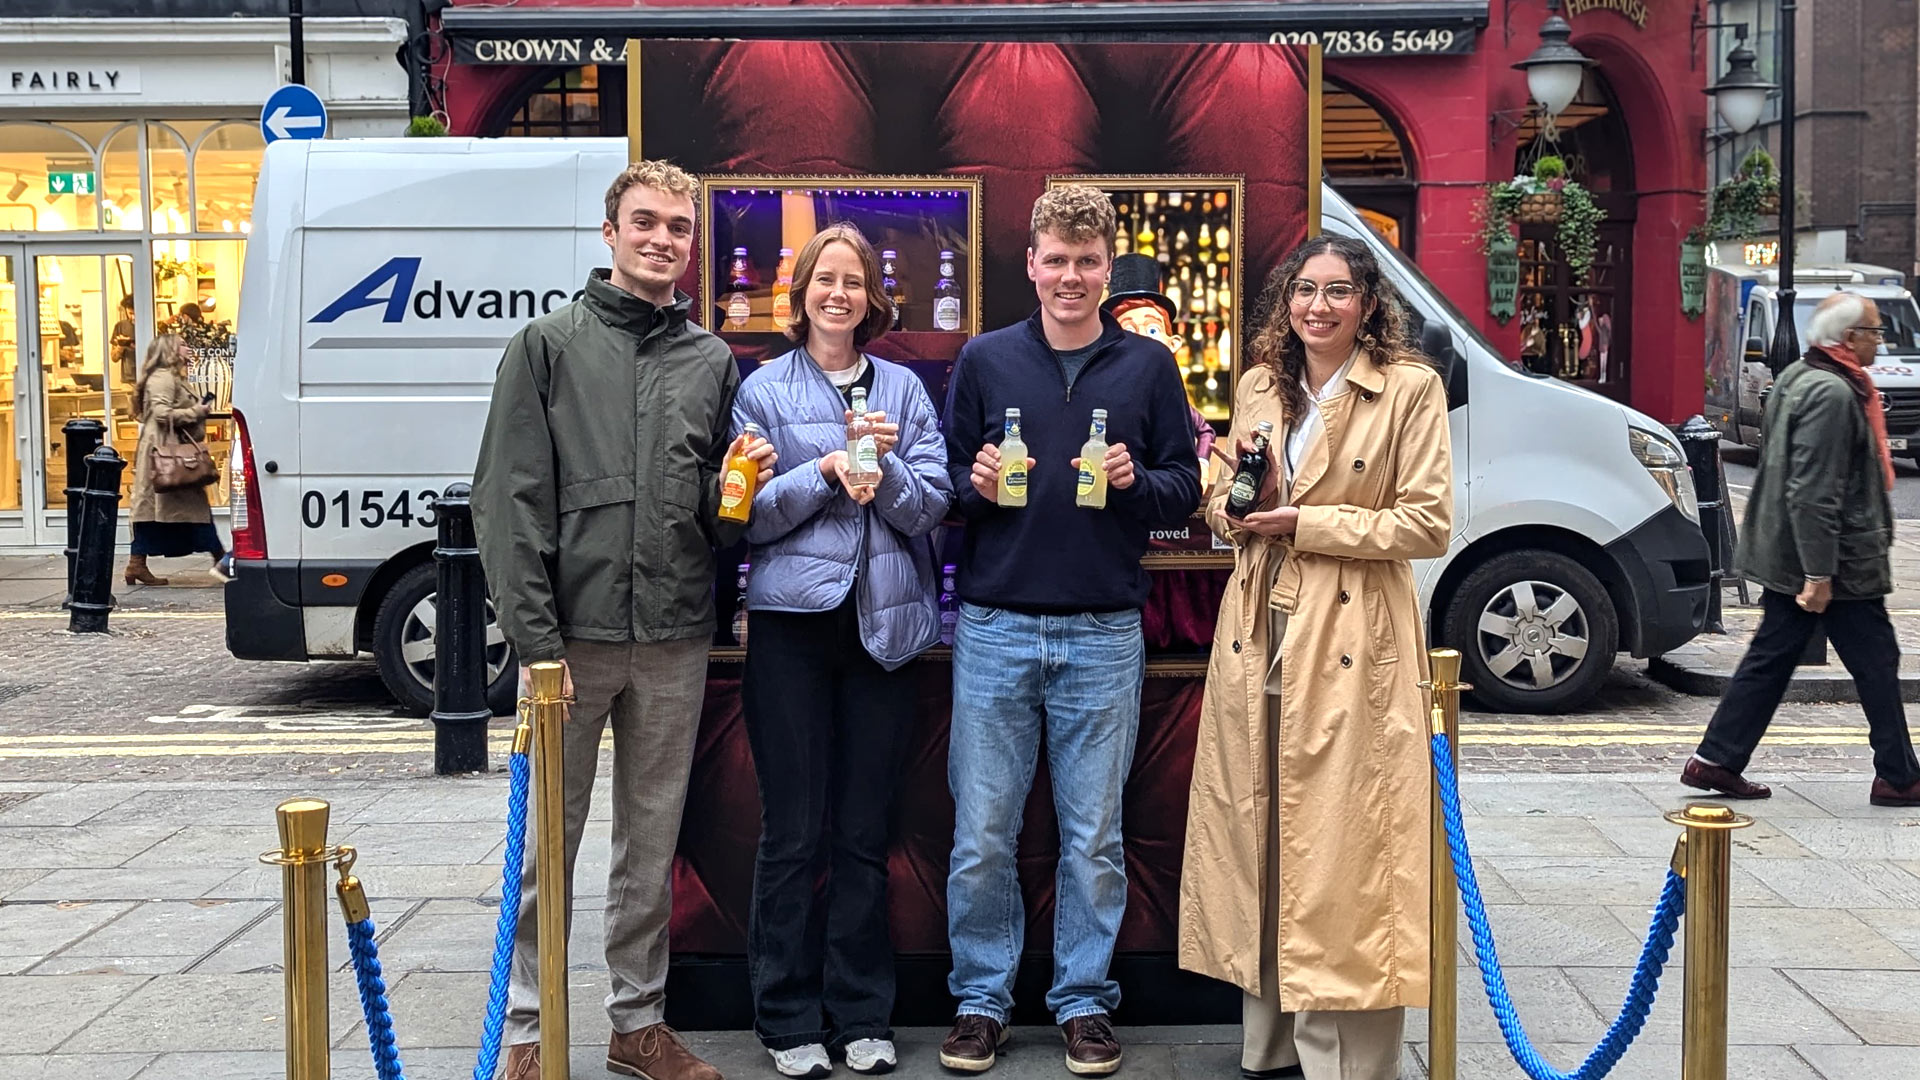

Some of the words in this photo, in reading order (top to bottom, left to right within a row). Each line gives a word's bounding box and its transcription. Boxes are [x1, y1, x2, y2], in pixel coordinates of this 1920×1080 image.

[474, 38, 582, 61] CROWN
[589, 37, 613, 61] &
[1322, 31, 1384, 54] 7836
[1391, 29, 1454, 52] 5649
[11, 71, 119, 88] FAIRLY
[307, 257, 586, 322] Advanc
[1865, 365, 1912, 374] SCO
[302, 490, 439, 528] 01543
[1149, 527, 1190, 539] roved
